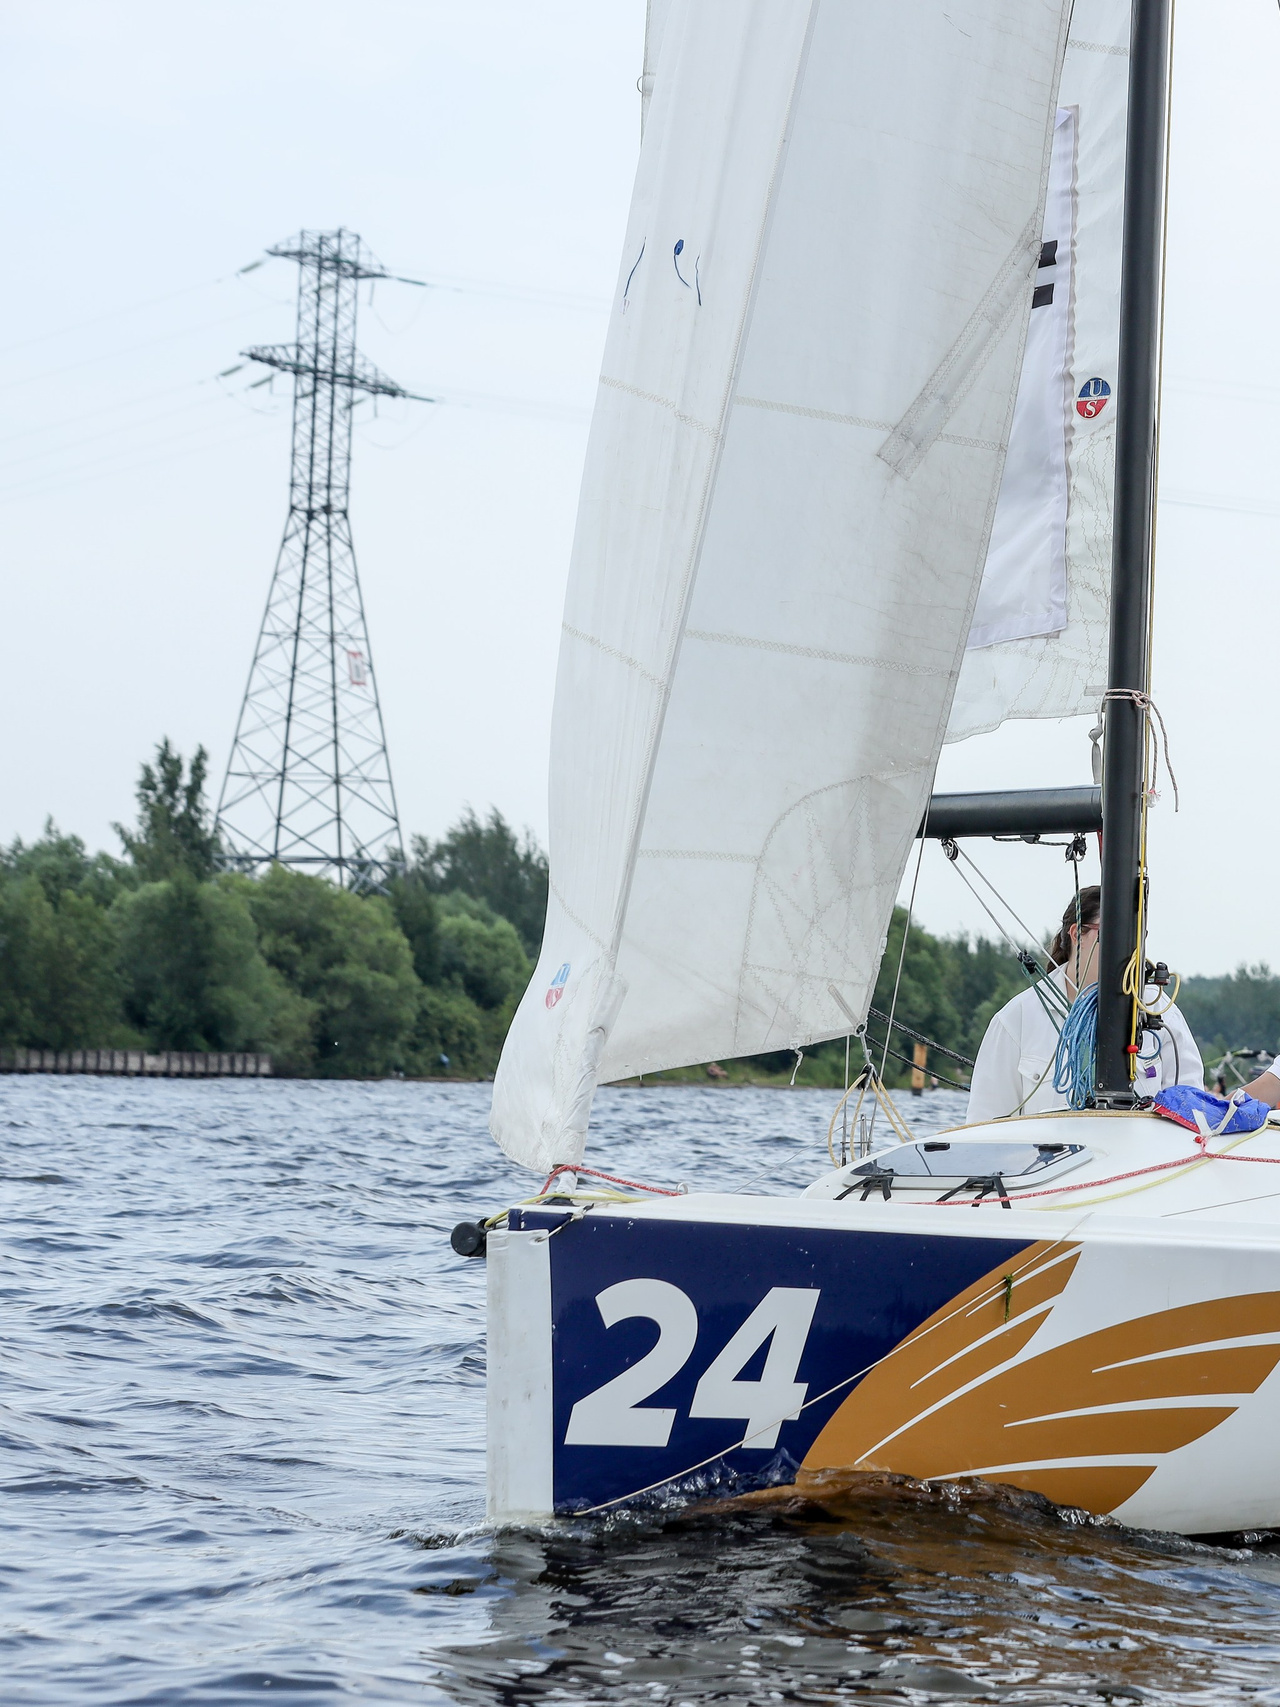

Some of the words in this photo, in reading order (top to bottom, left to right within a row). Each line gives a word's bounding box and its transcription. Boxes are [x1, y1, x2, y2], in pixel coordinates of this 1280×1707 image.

[1089, 380, 1103, 397] U
[1084, 400, 1097, 417] S
[563, 1278, 821, 1449] 24
